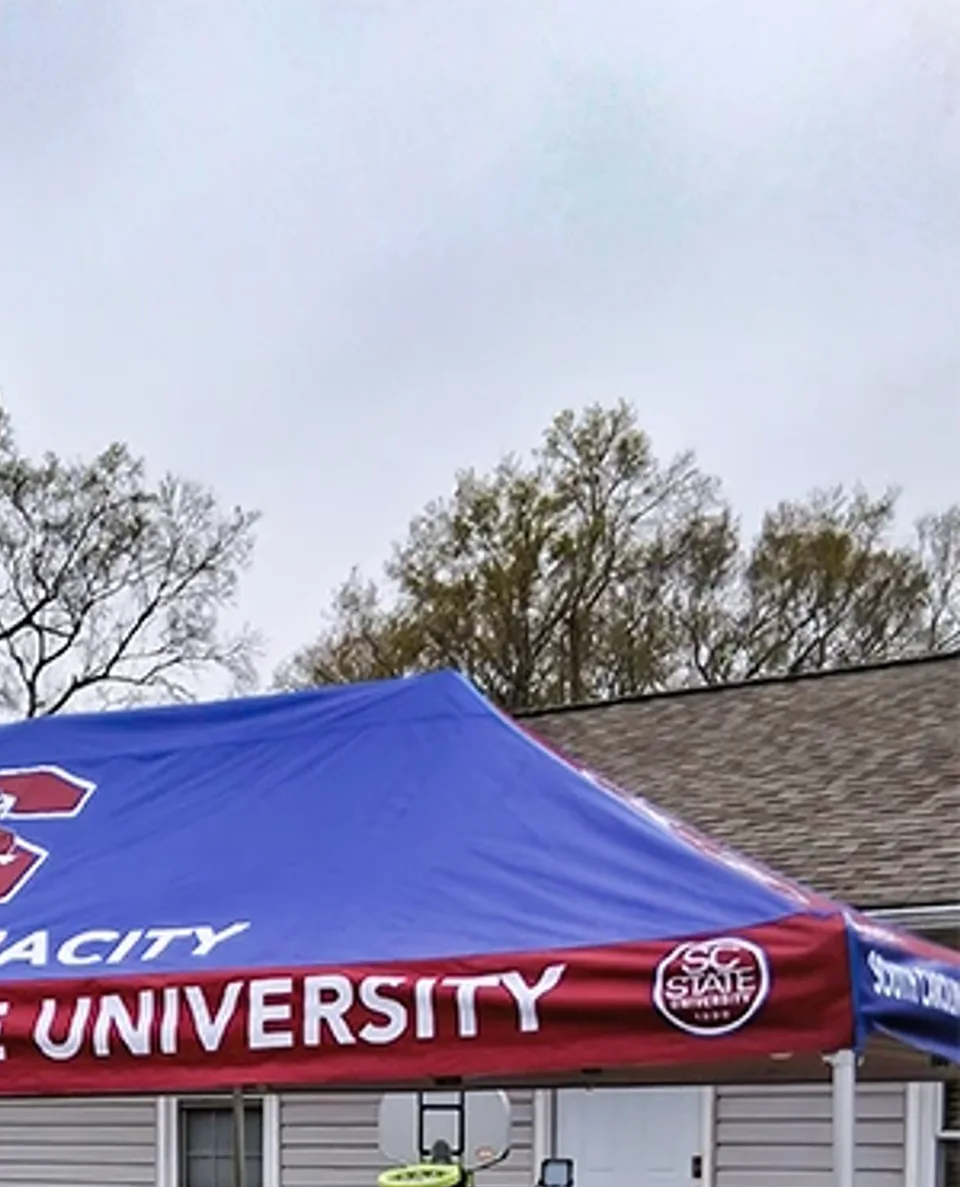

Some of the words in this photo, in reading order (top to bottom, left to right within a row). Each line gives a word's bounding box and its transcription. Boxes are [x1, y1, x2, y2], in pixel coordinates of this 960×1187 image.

[681, 943, 741, 973] SC
[665, 966, 757, 1000] STATE
[34, 964, 565, 1059] UNIVERSITY
